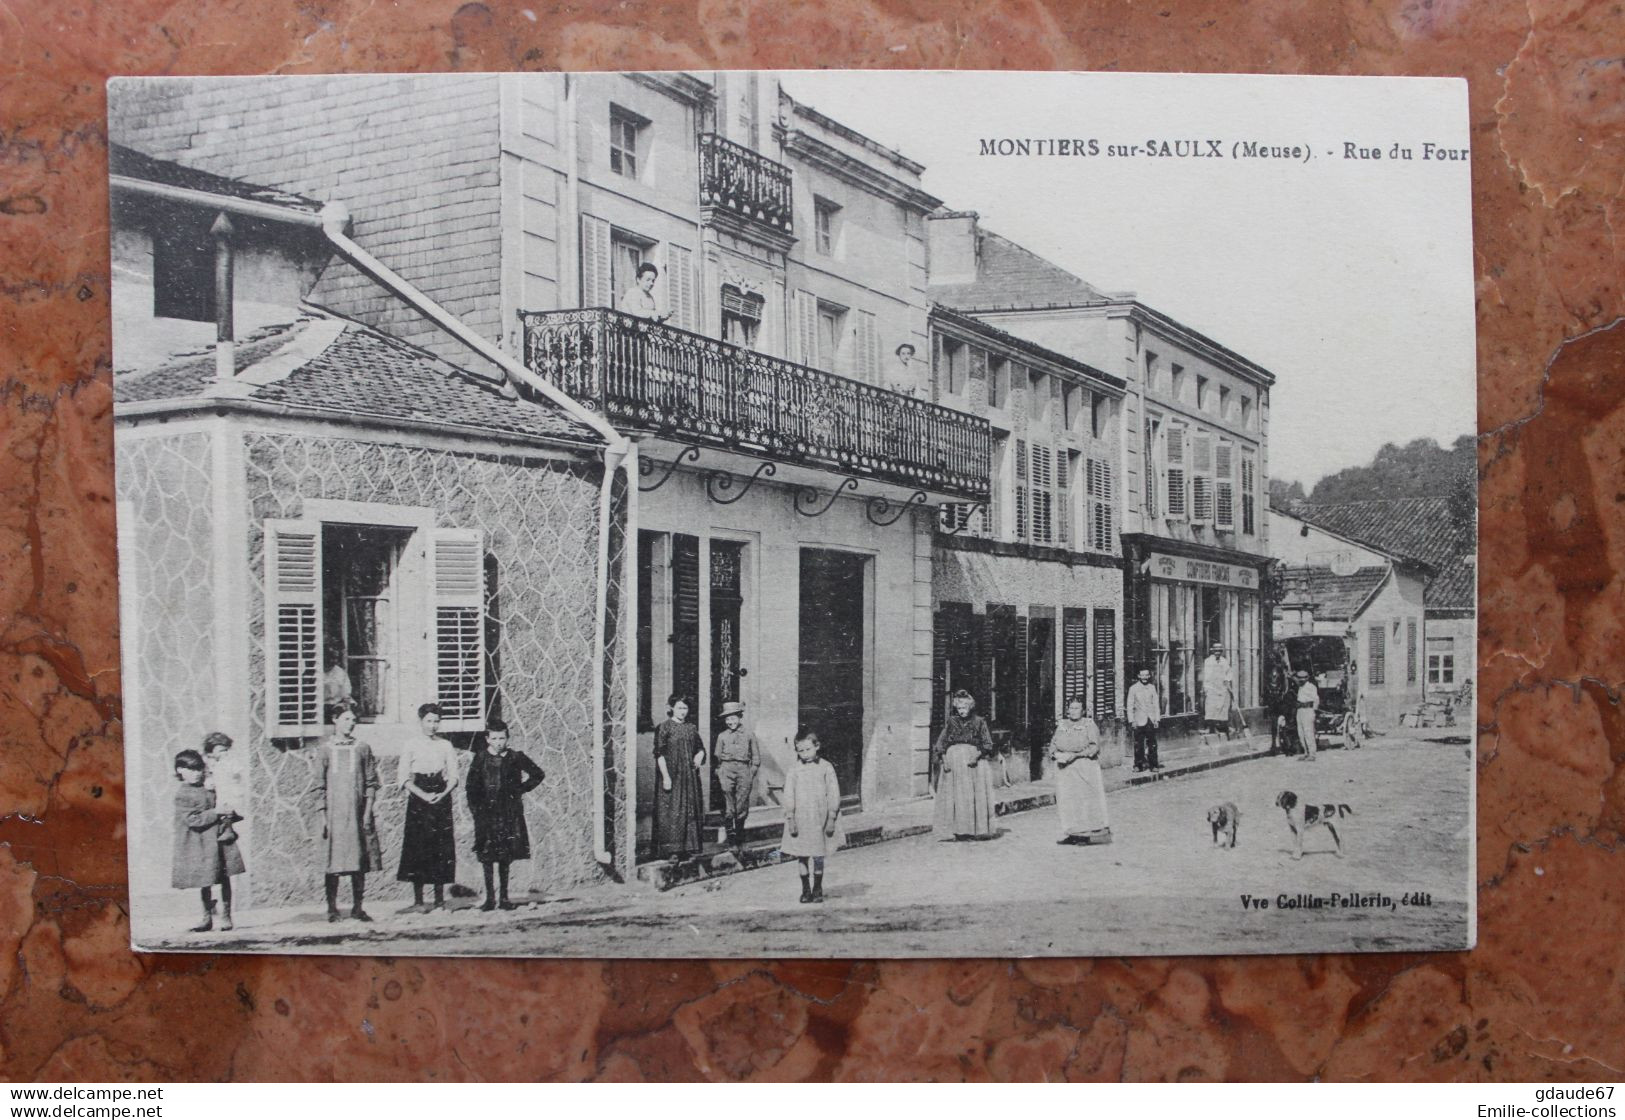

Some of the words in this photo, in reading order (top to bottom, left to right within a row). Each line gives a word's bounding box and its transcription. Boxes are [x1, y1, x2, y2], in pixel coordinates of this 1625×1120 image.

[979, 138, 1100, 157] MONTIERS
[1107, 139, 1224, 158] sur-SAULX
[1343, 142, 1382, 160] Rue
[1388, 142, 1413, 161] du
[1422, 143, 1469, 161] Four
[1240, 894, 1269, 910] Vve
[1276, 892, 1397, 912] Collin-Pellerin,
[1401, 892, 1432, 907] édit
